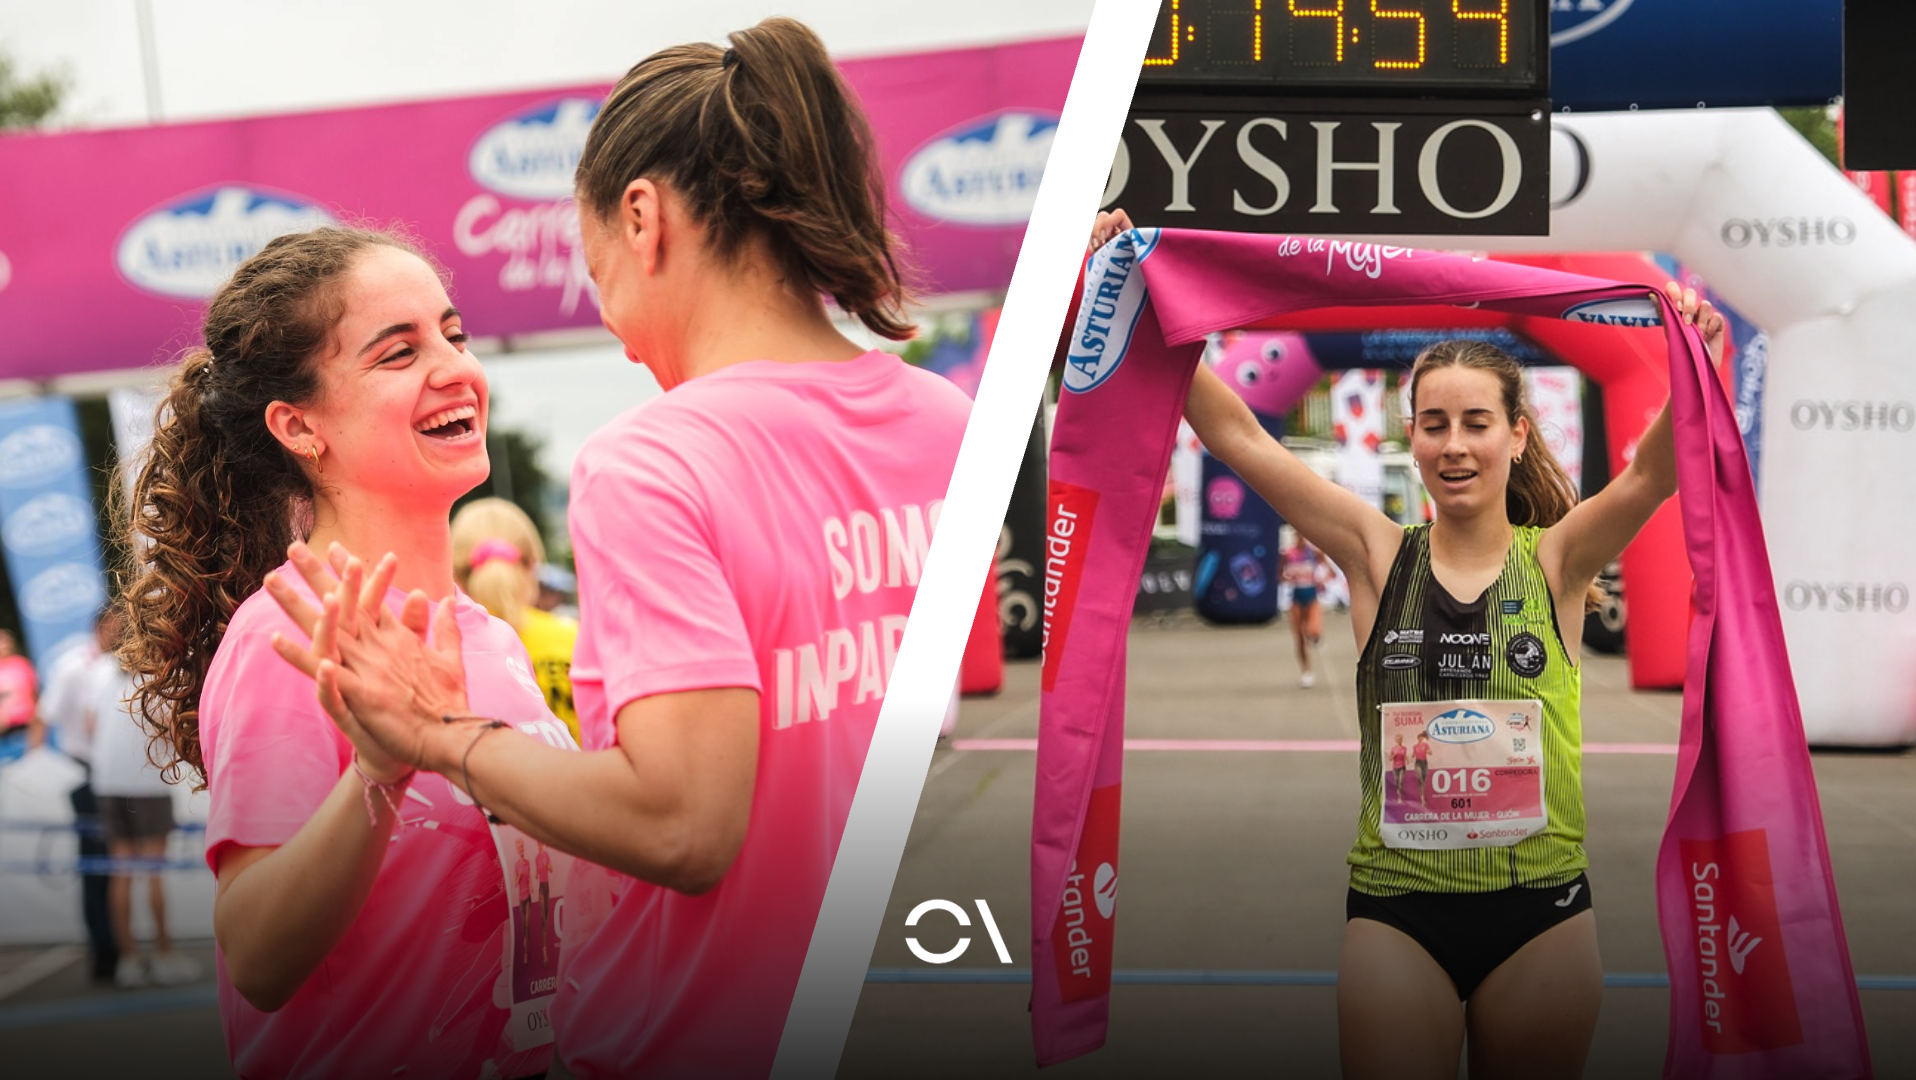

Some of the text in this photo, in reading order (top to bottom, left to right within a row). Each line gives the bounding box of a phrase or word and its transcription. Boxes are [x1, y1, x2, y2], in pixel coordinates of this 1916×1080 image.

[1721, 216, 1856, 249] OYSHO
[1278, 236, 1302, 257] de
[1307, 238, 1325, 253] la
[1790, 399, 1916, 434] OYSHO
[1041, 504, 1078, 668] antander
[1783, 579, 1910, 614] OYSHO
[1394, 716, 1424, 727] SUMA
[1432, 723, 1491, 736] ASTURIANA
[1432, 768, 1491, 793] 016
[1451, 798, 1472, 809] 601
[1404, 812, 1439, 822] CARRERA
[1440, 812, 1451, 821] DE
[1452, 811, 1463, 820] LA
[1464, 811, 1490, 820] MUJER
[1398, 828, 1528, 841] OYSHO Santander
[1693, 861, 1726, 1034] Santander
